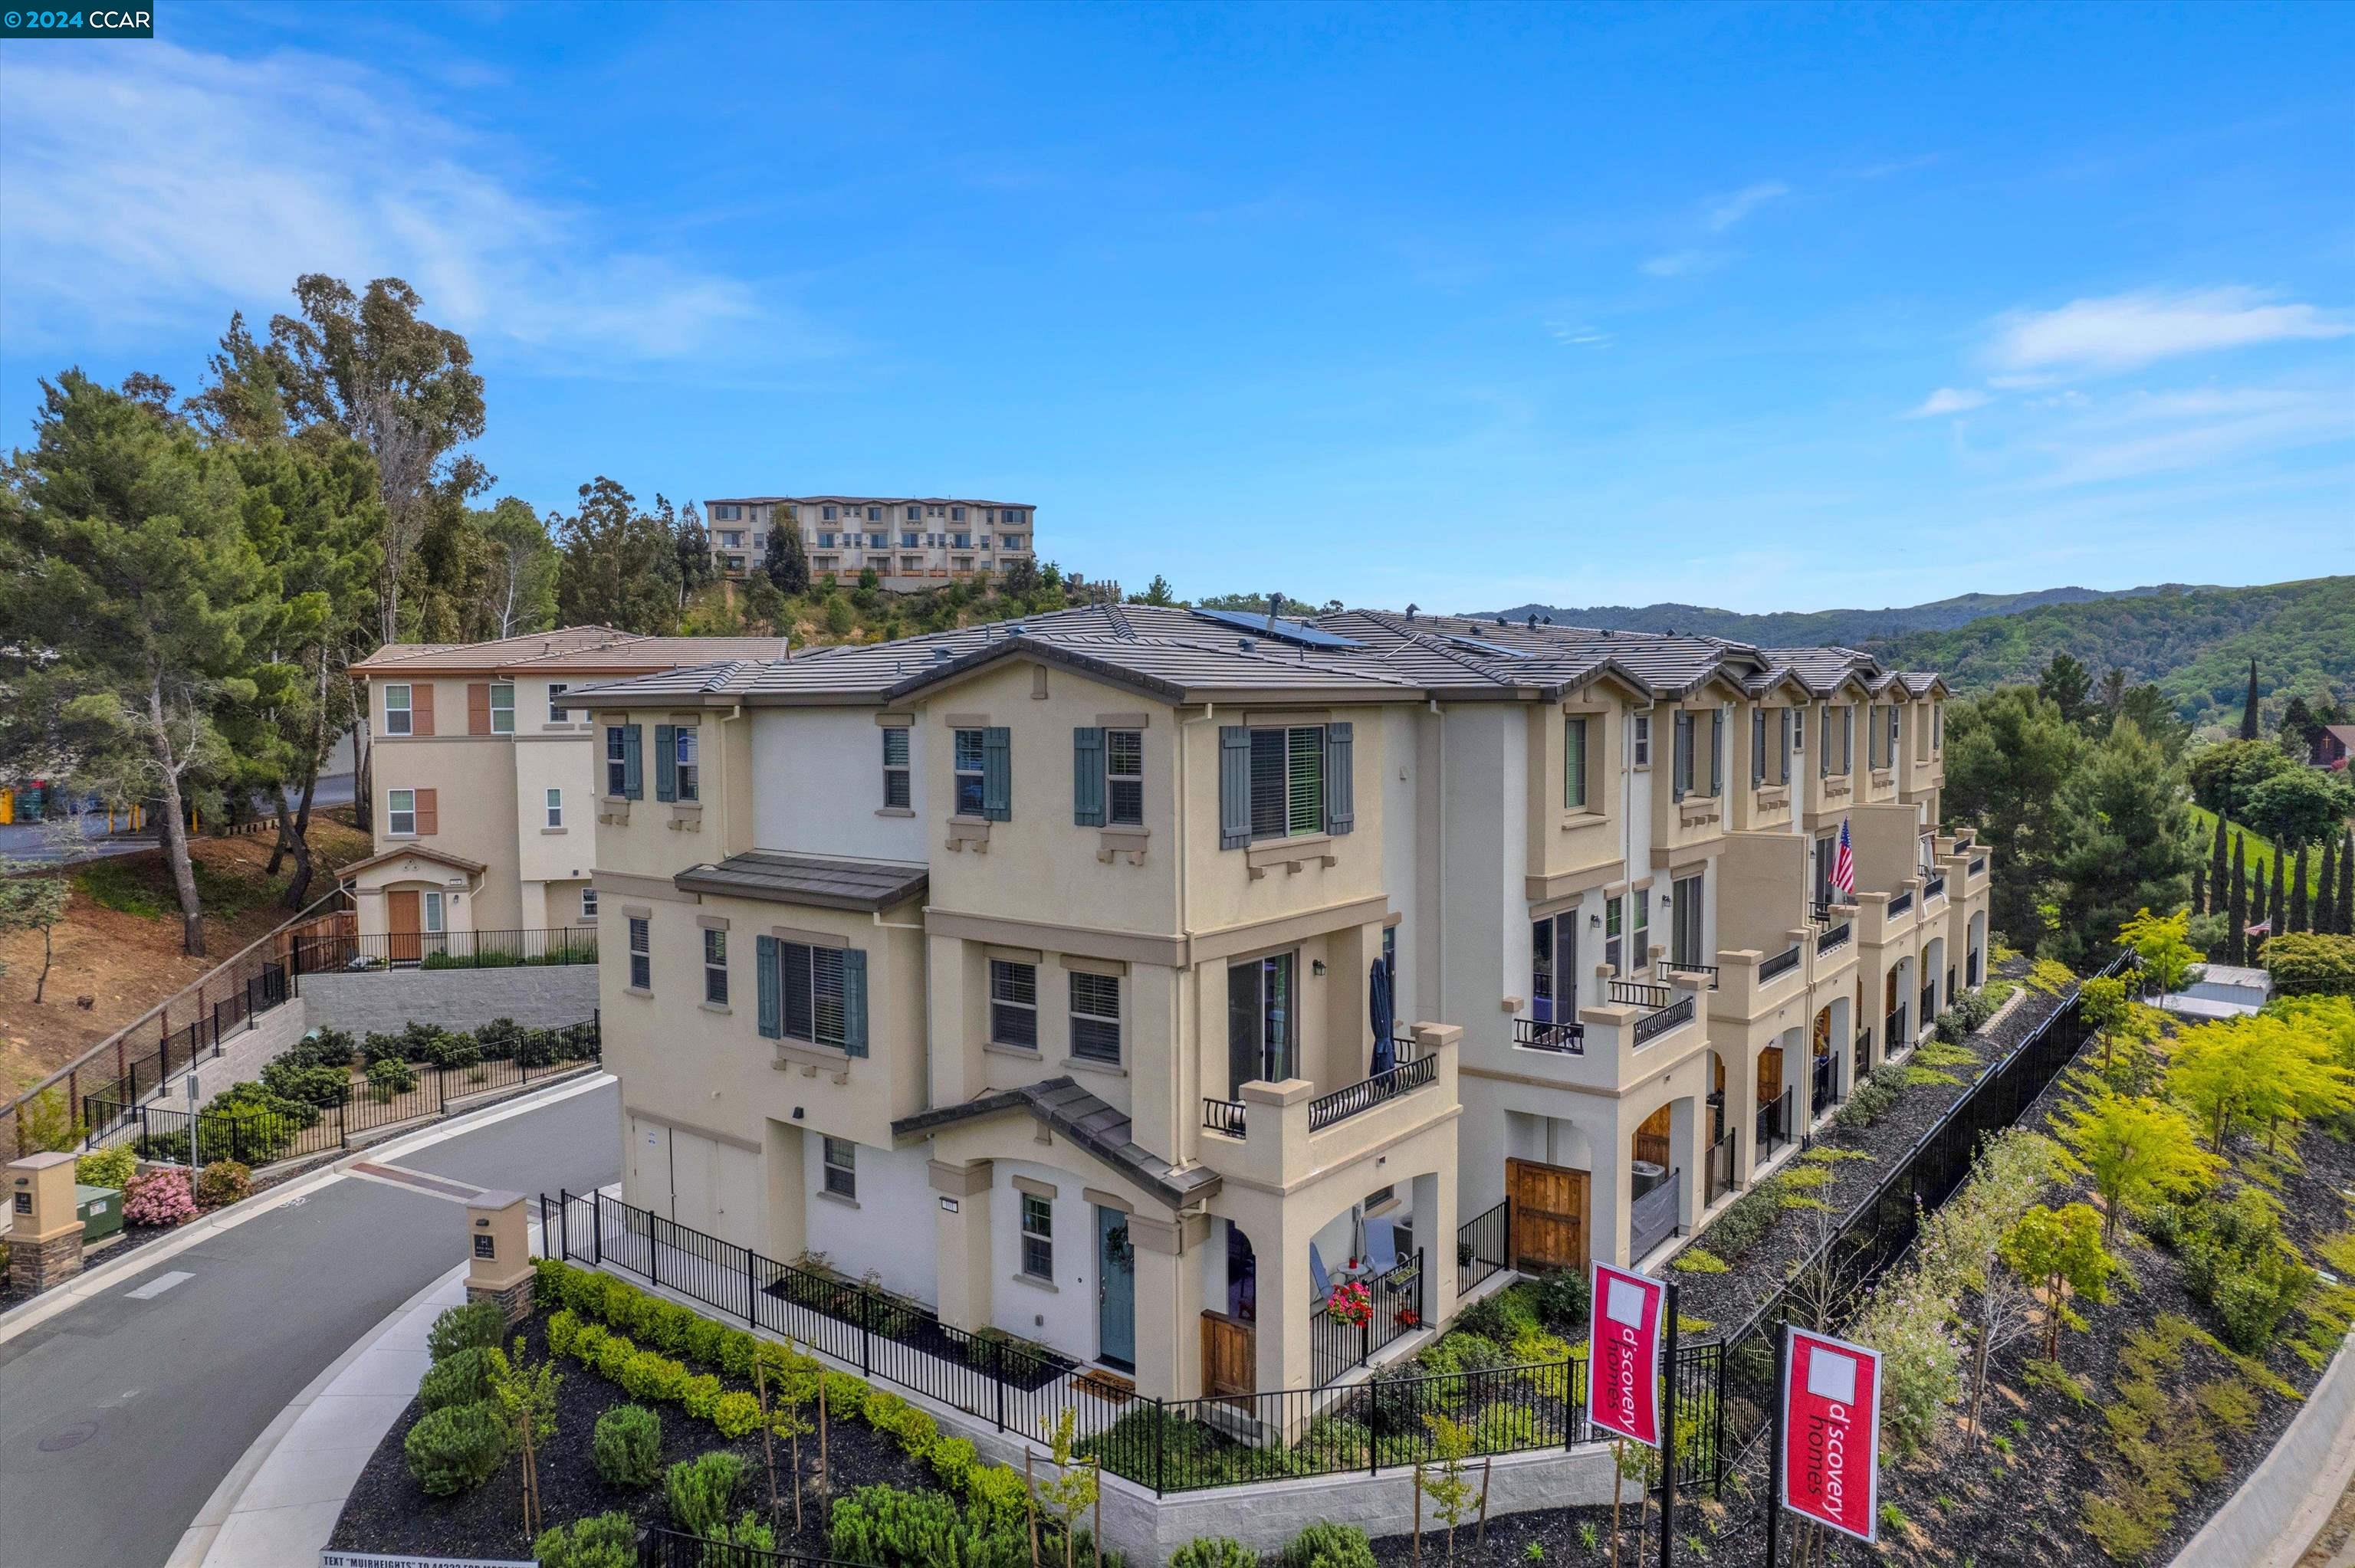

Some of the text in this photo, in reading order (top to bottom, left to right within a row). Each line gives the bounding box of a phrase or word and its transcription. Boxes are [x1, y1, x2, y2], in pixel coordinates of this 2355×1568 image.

[1607, 1337, 1631, 1410] homes
[1618, 1328, 1638, 1432] discovery
[1808, 1415, 1842, 1494] homes
[1822, 1404, 1851, 1520] discovery
[324, 1556, 344, 1566] TEXT
